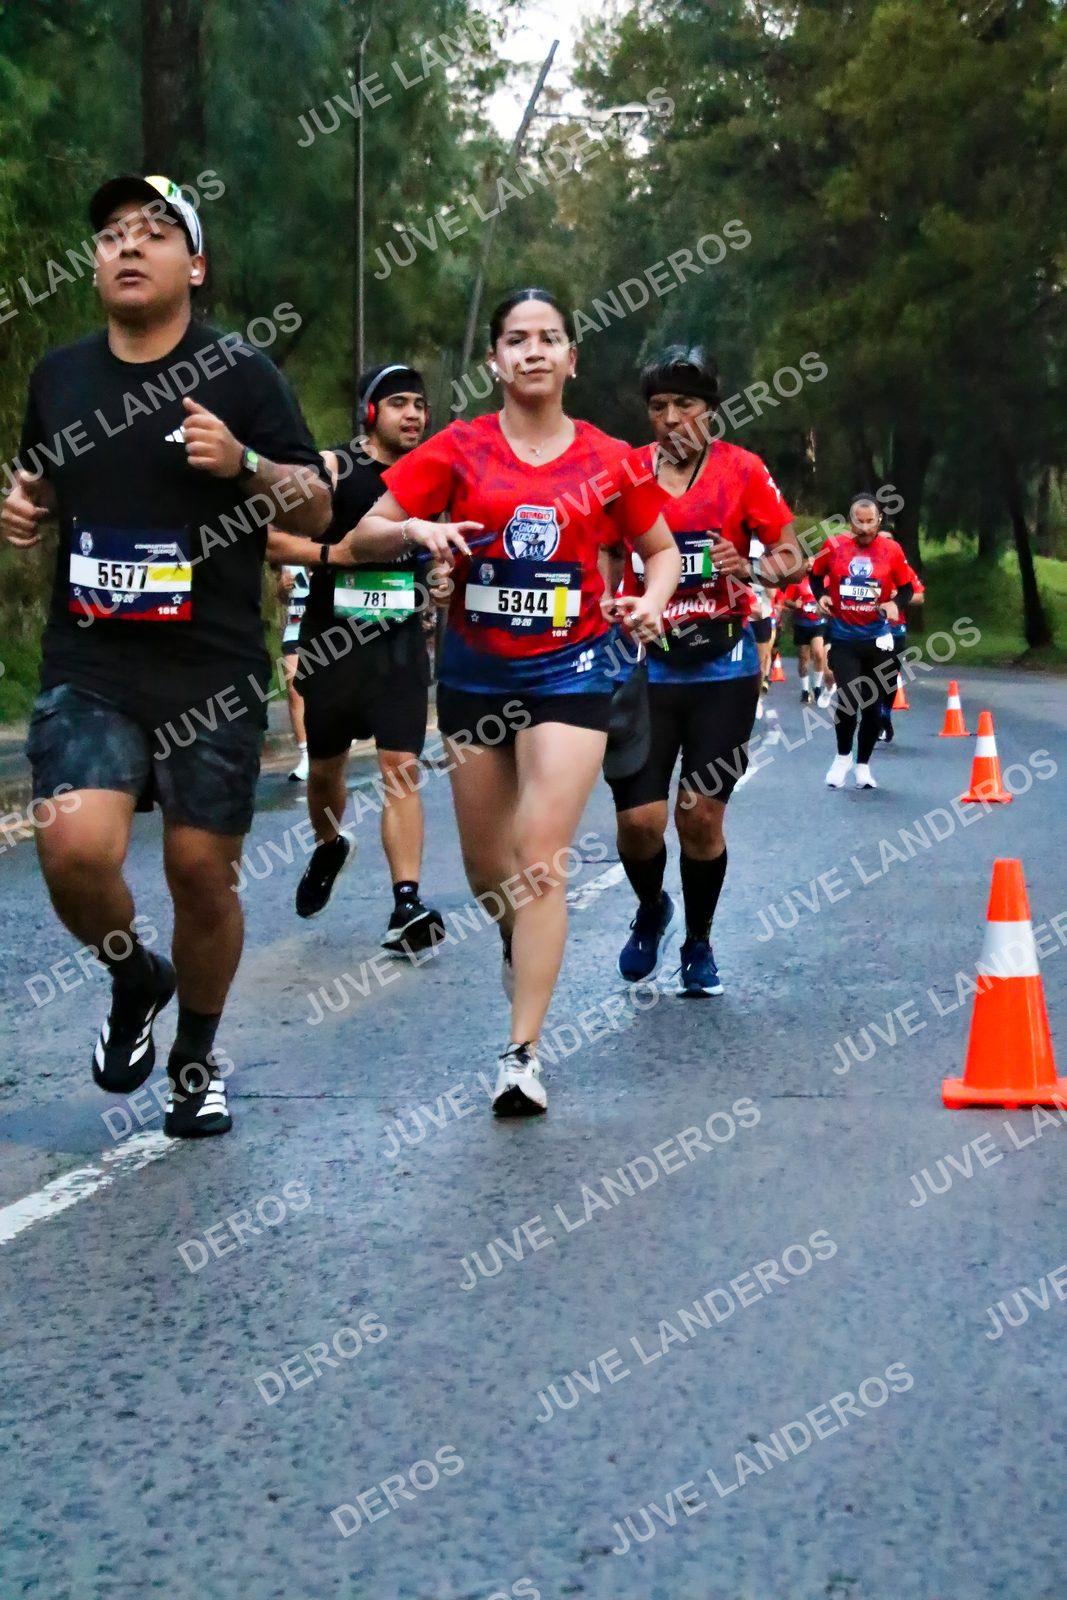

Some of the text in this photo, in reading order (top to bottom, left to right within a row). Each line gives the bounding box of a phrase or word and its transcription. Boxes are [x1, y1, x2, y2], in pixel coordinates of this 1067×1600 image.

[98, 562, 148, 589] 5577
[852, 587, 869, 597] 5167
[363, 592, 387, 607] 781
[497, 589, 548, 615] 5344
[157, 606, 178, 615] 10K
[551, 629, 568, 638] 10K
